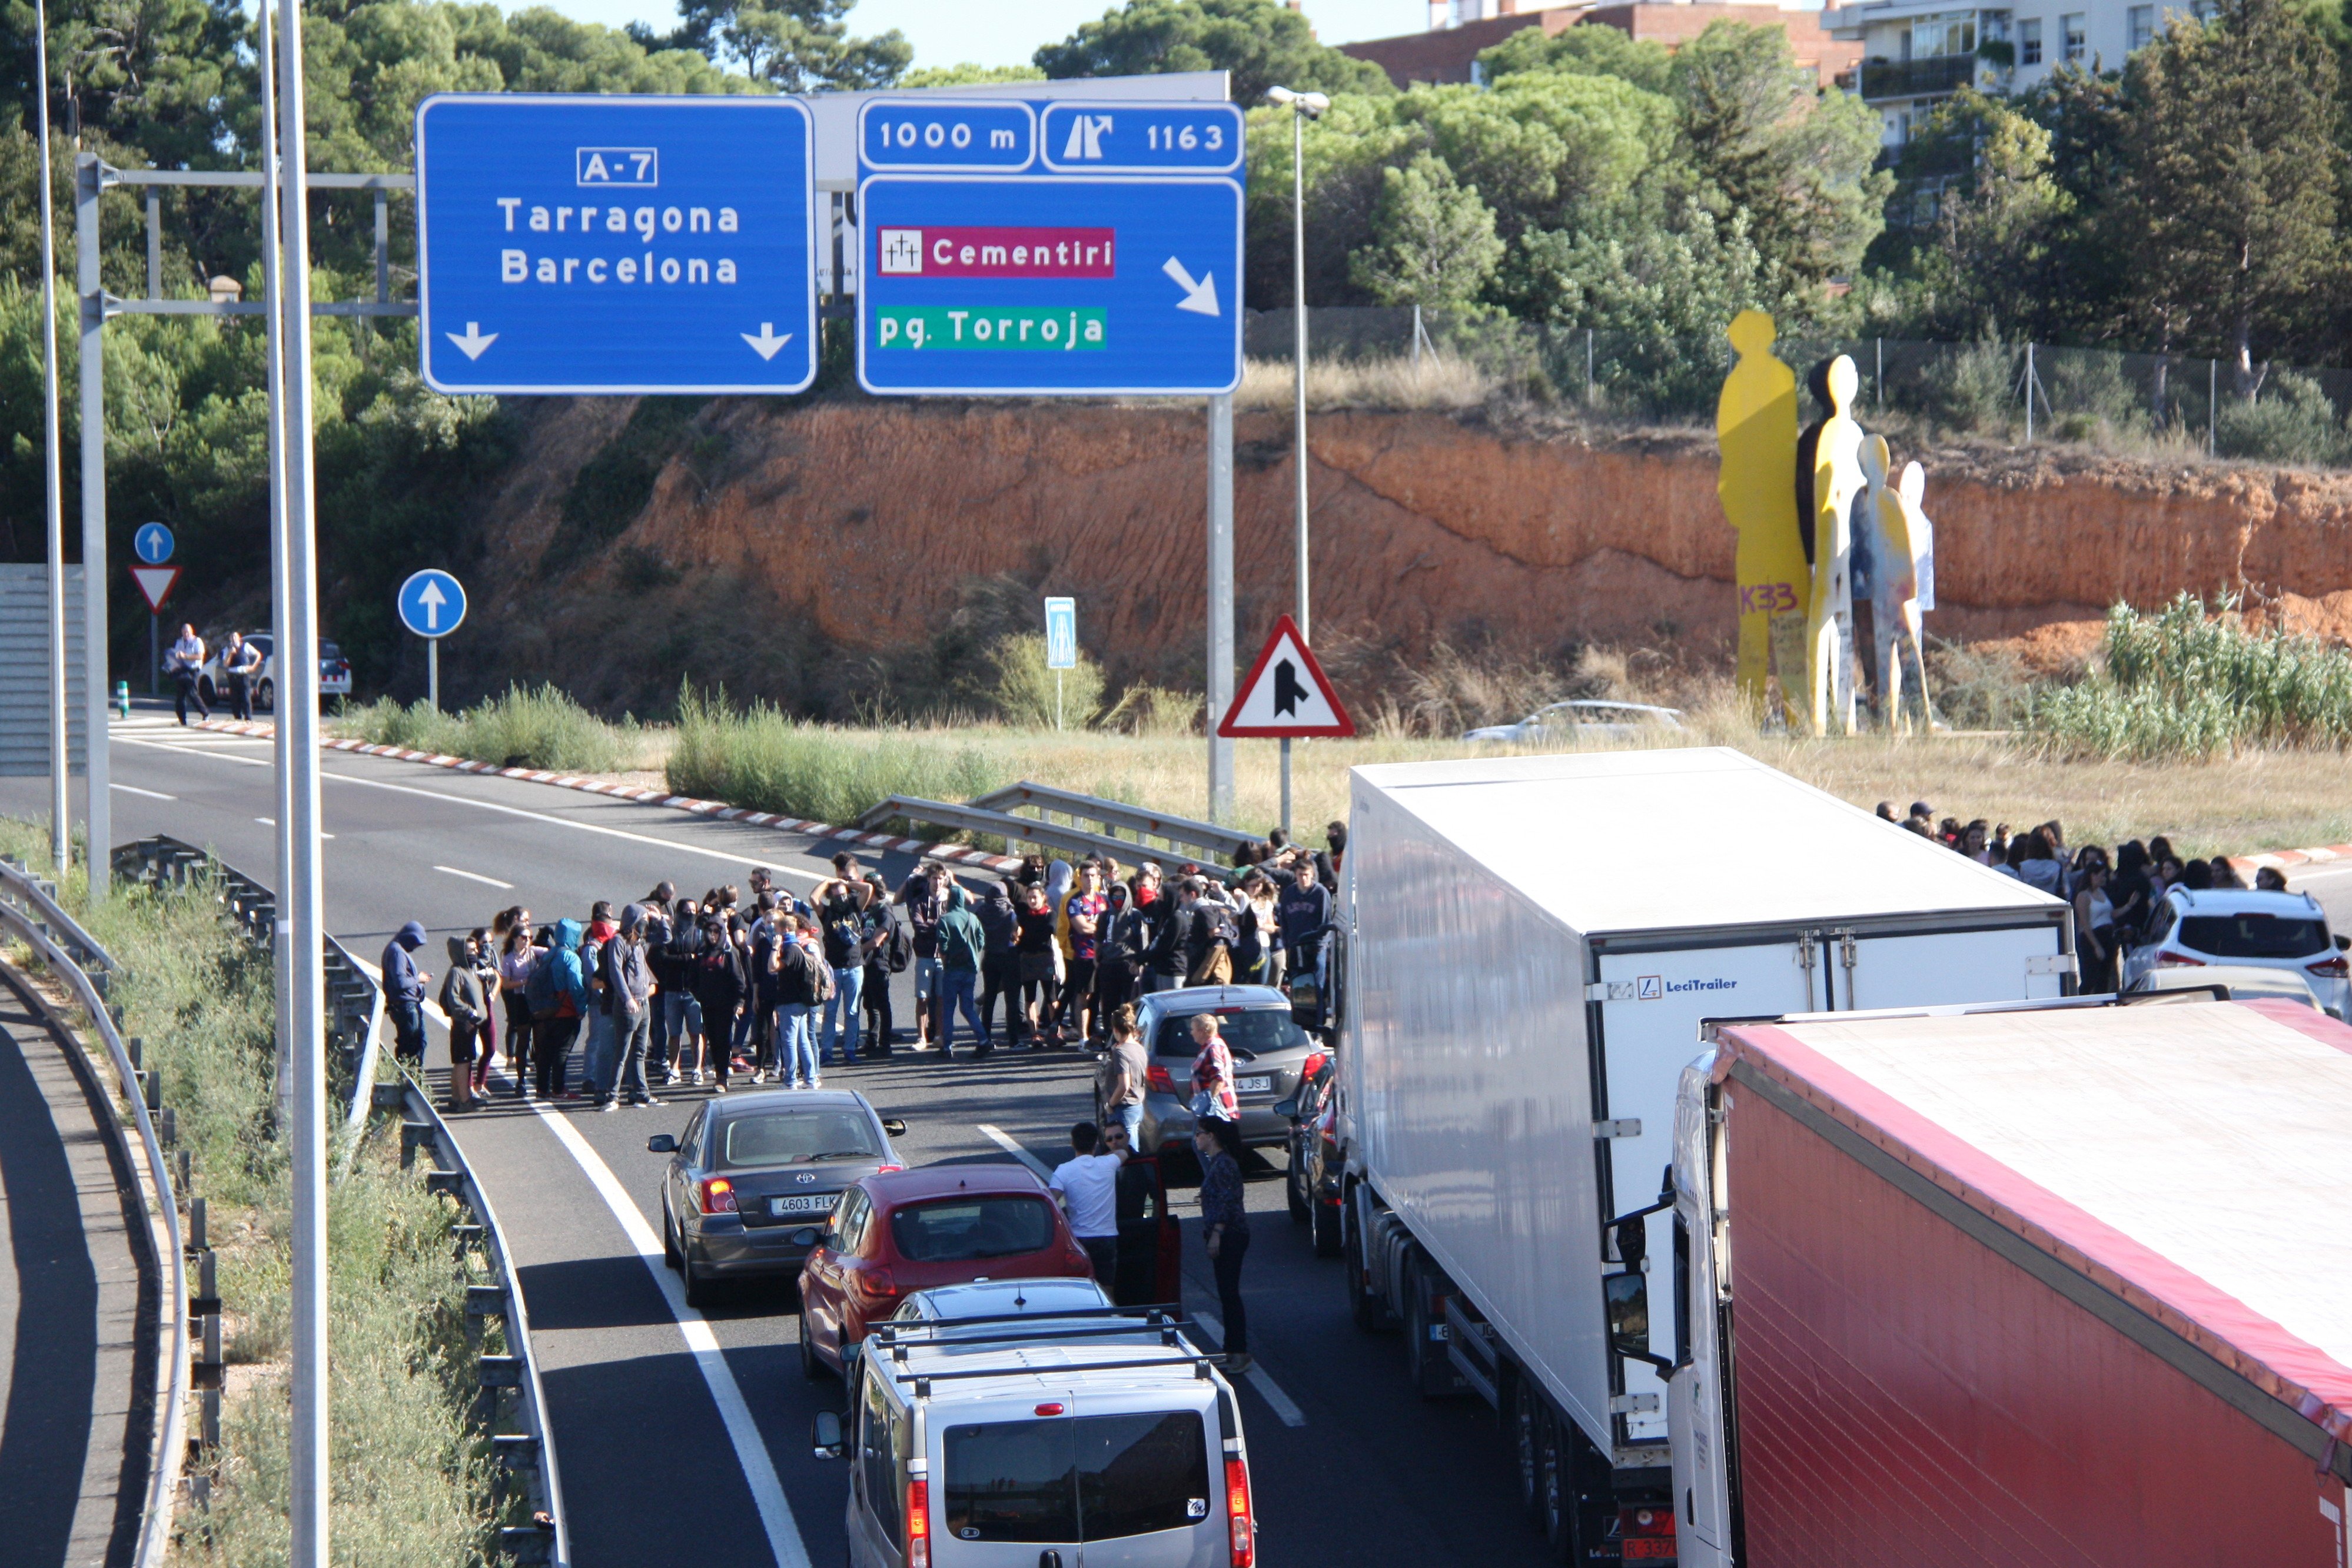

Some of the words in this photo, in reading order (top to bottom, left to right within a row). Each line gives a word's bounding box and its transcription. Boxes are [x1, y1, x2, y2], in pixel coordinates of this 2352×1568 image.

[881, 122, 971, 148] 1000
[991, 128, 1015, 148] m
[1148, 125, 1223, 150] 1163
[584, 154, 652, 180] A-7
[497, 198, 738, 242] Tarragona
[933, 239, 1111, 266] Cementiri
[501, 250, 737, 283] Barcelona
[881, 317, 932, 349] pg.
[948, 311, 1102, 350] Torroja
[1740, 582, 1799, 615] K33
[1666, 978, 1738, 992] LeciTrailer
[1248, 1078, 1268, 1089] JSJ
[782, 1198, 810, 1211] 4603
[815, 1196, 836, 1208] FLK
[1627, 1541, 1636, 1557] R
